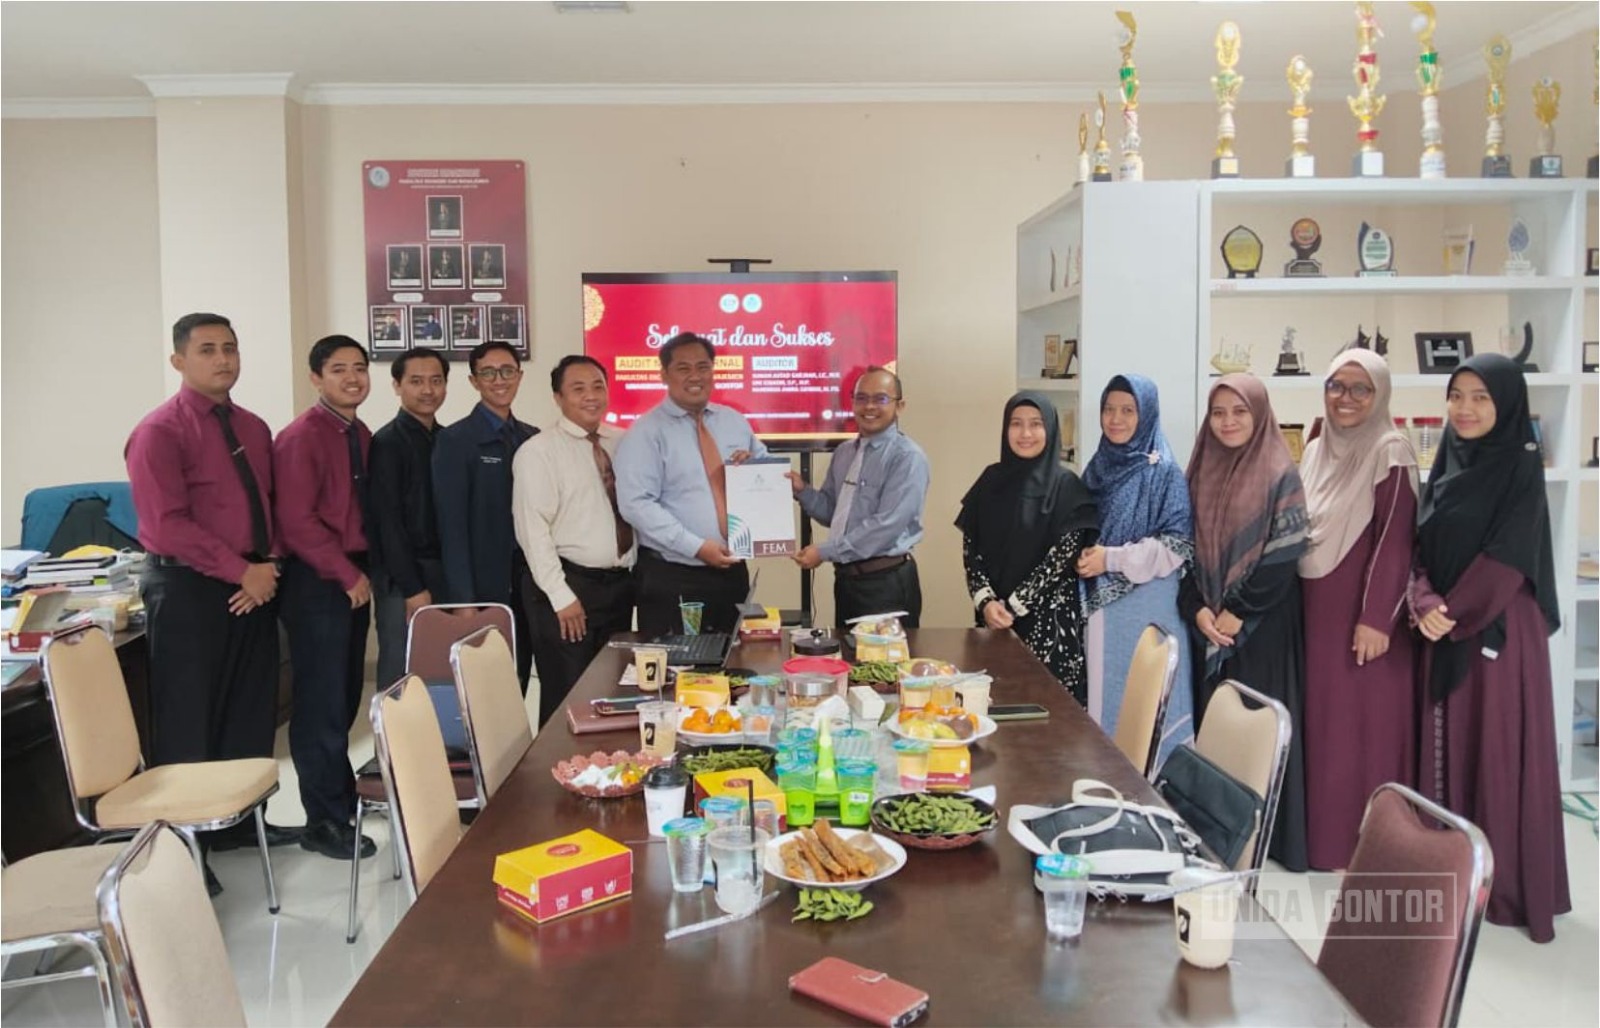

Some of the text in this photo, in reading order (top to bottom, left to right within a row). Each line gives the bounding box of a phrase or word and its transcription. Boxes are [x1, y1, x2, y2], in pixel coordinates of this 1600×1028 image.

[728, 325, 767, 346] dan
[770, 322, 834, 348] Sukses
[618, 359, 652, 368] AUDIT
[762, 542, 787, 554] FEM
